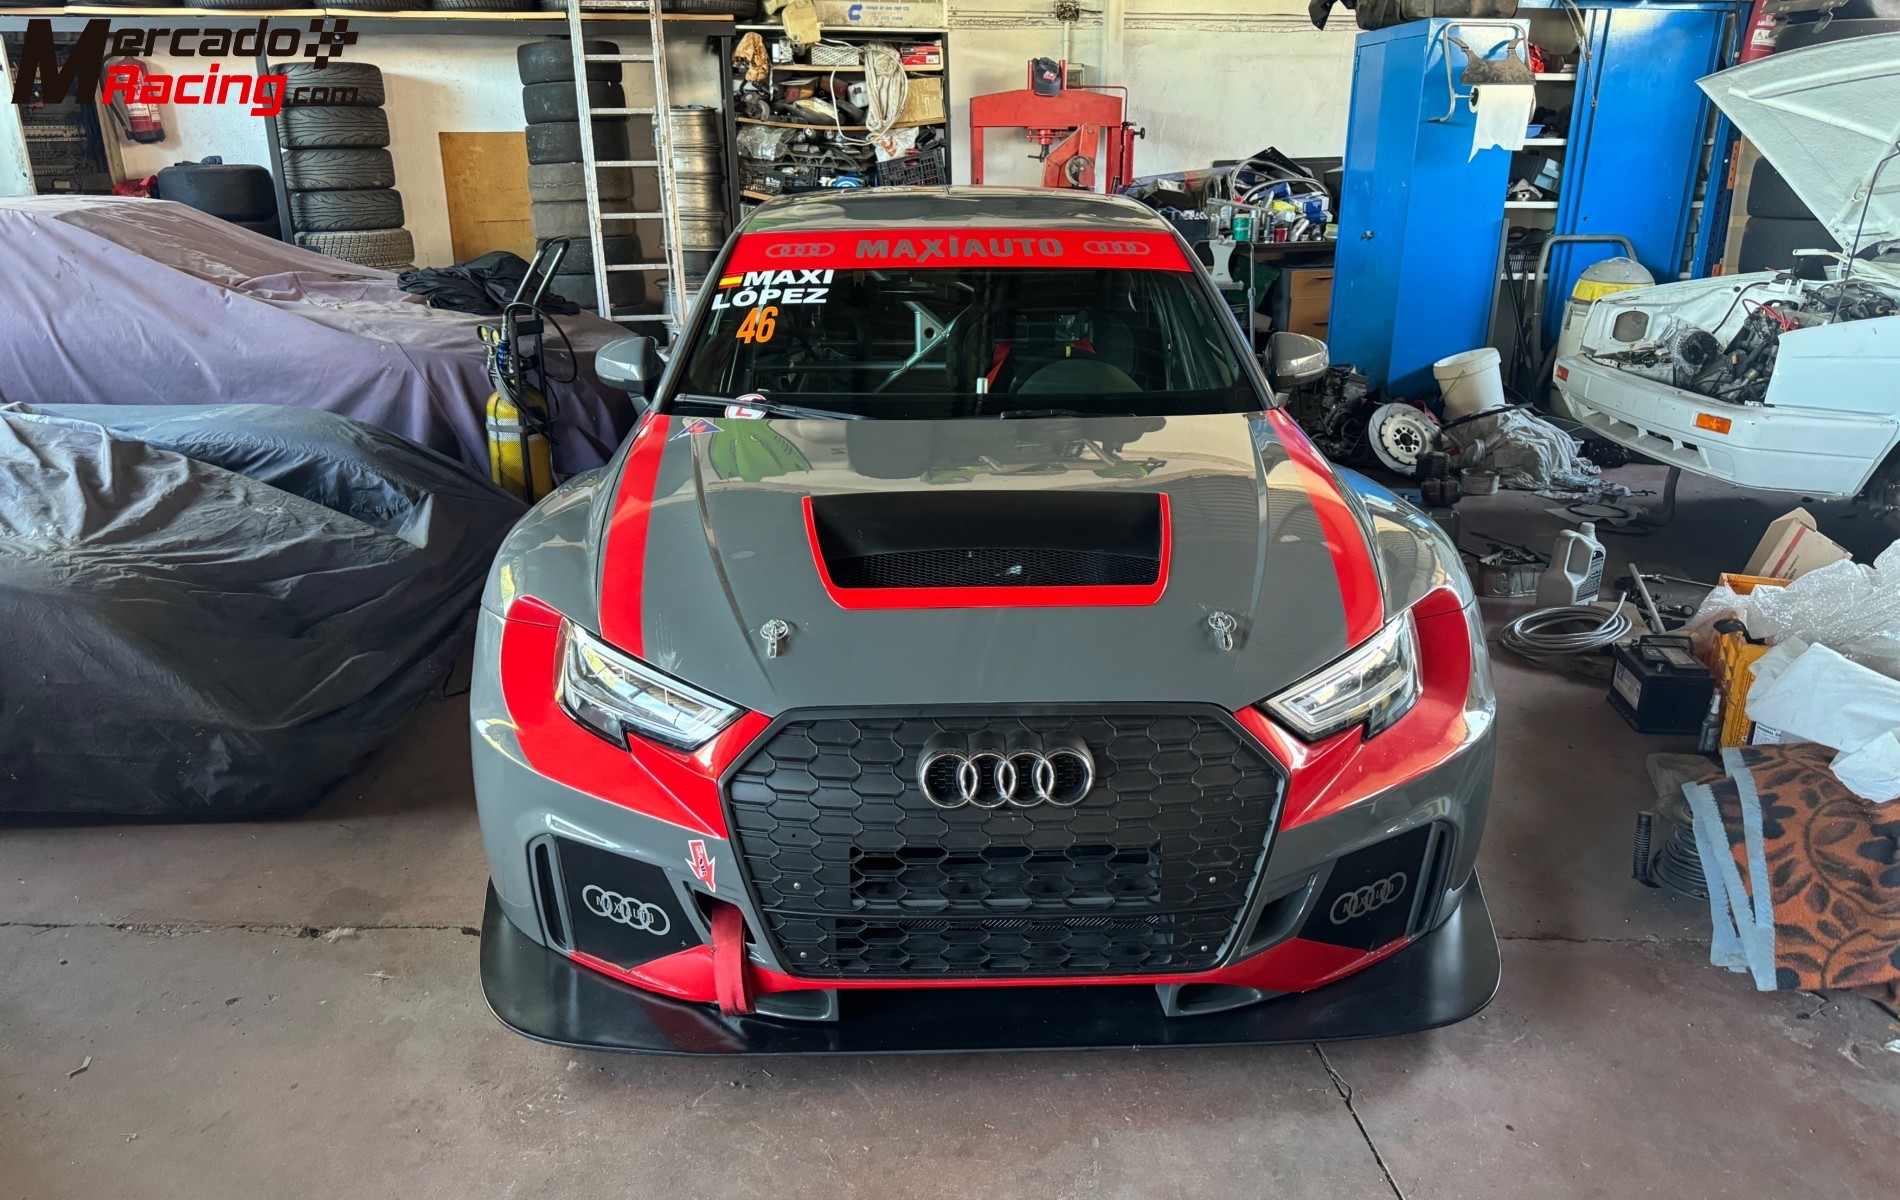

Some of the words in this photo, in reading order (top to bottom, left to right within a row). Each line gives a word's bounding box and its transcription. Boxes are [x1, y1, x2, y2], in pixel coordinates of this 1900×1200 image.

[743, 269, 834, 287] MAXI
[711, 286, 829, 310] LÓPEZ
[735, 306, 779, 344] 46
